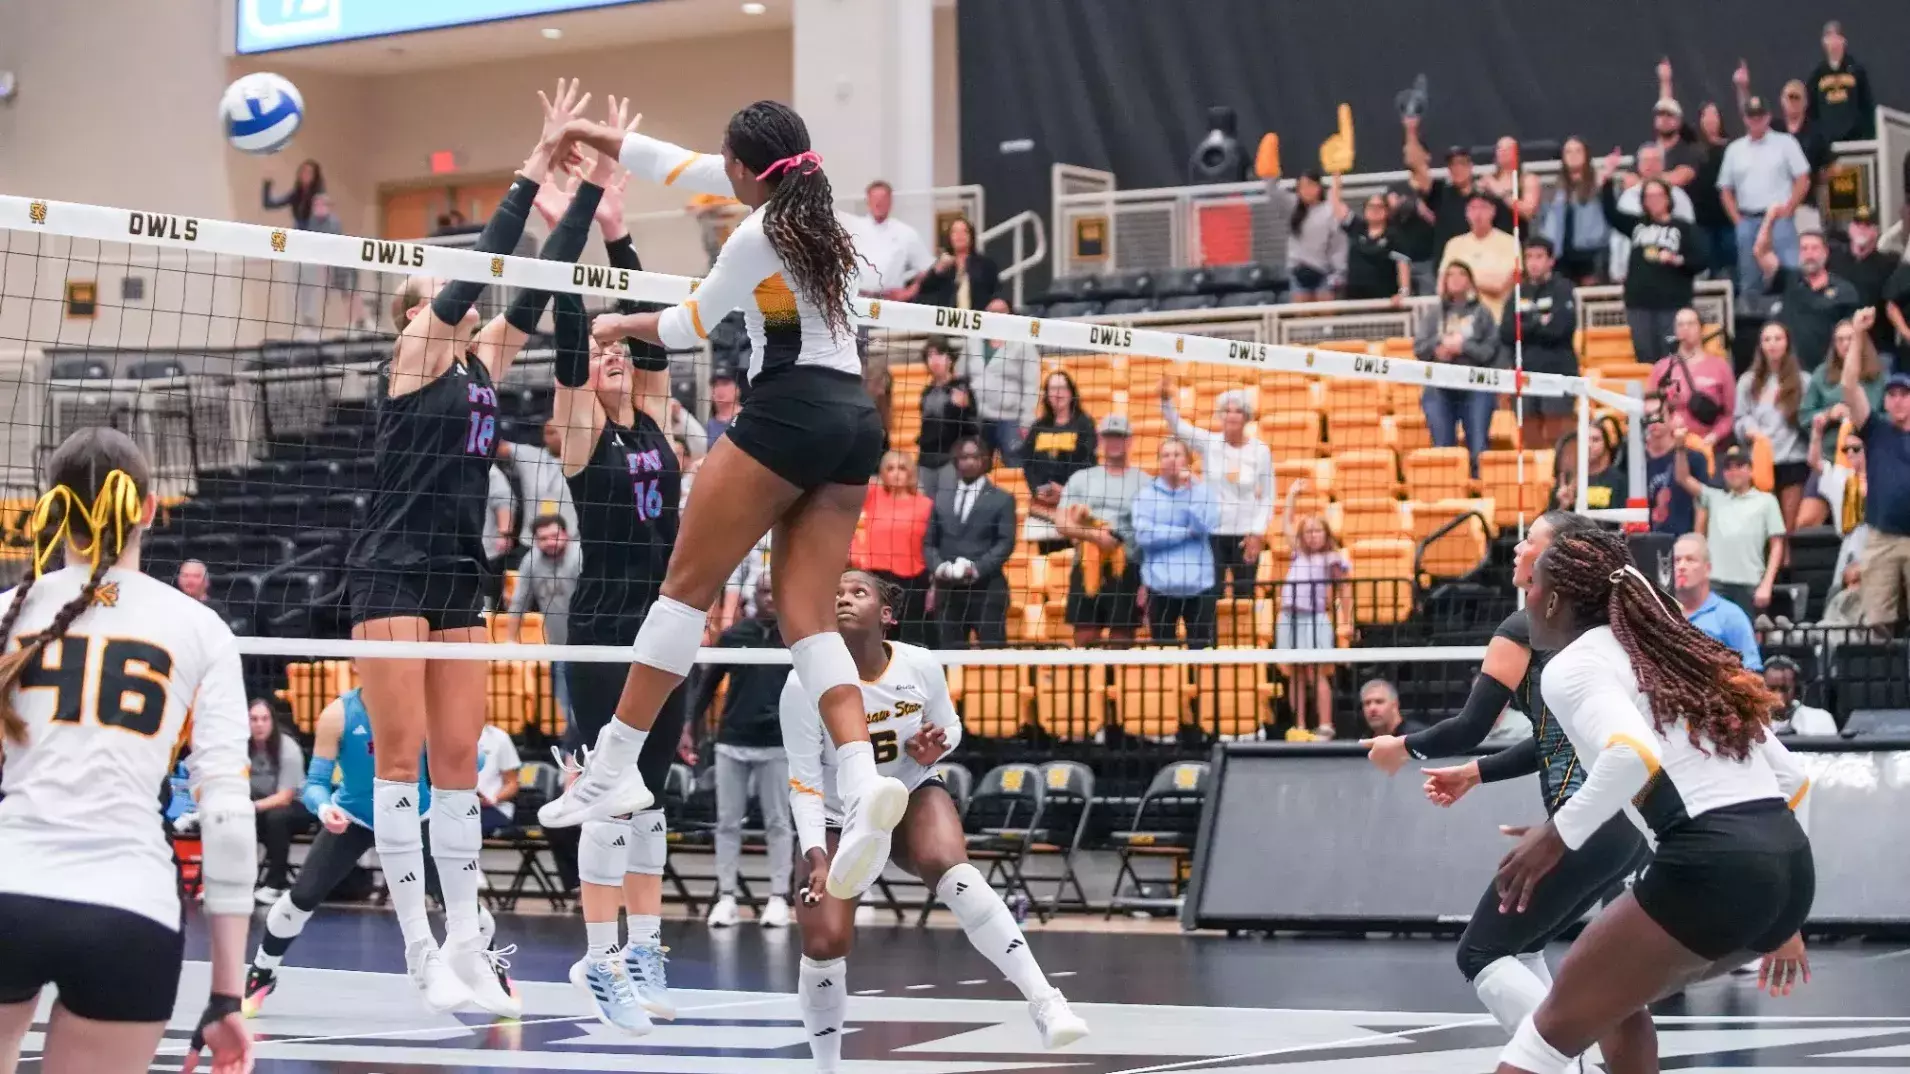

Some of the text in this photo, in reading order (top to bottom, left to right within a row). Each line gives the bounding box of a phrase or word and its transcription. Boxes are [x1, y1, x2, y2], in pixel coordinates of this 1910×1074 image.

[129, 212, 198, 241] OWLS
[361, 240, 424, 267] OWLS
[572, 265, 630, 291] OWLS
[935, 308, 982, 330] OWLS
[1090, 327, 1132, 347] OWLS
[1229, 342, 1266, 362] OWLS
[1354, 356, 1390, 375] OWLS
[1468, 368, 1500, 386] OWLS
[466, 410, 495, 456] 18
[634, 479, 663, 521] 16
[16, 633, 174, 738] 46
